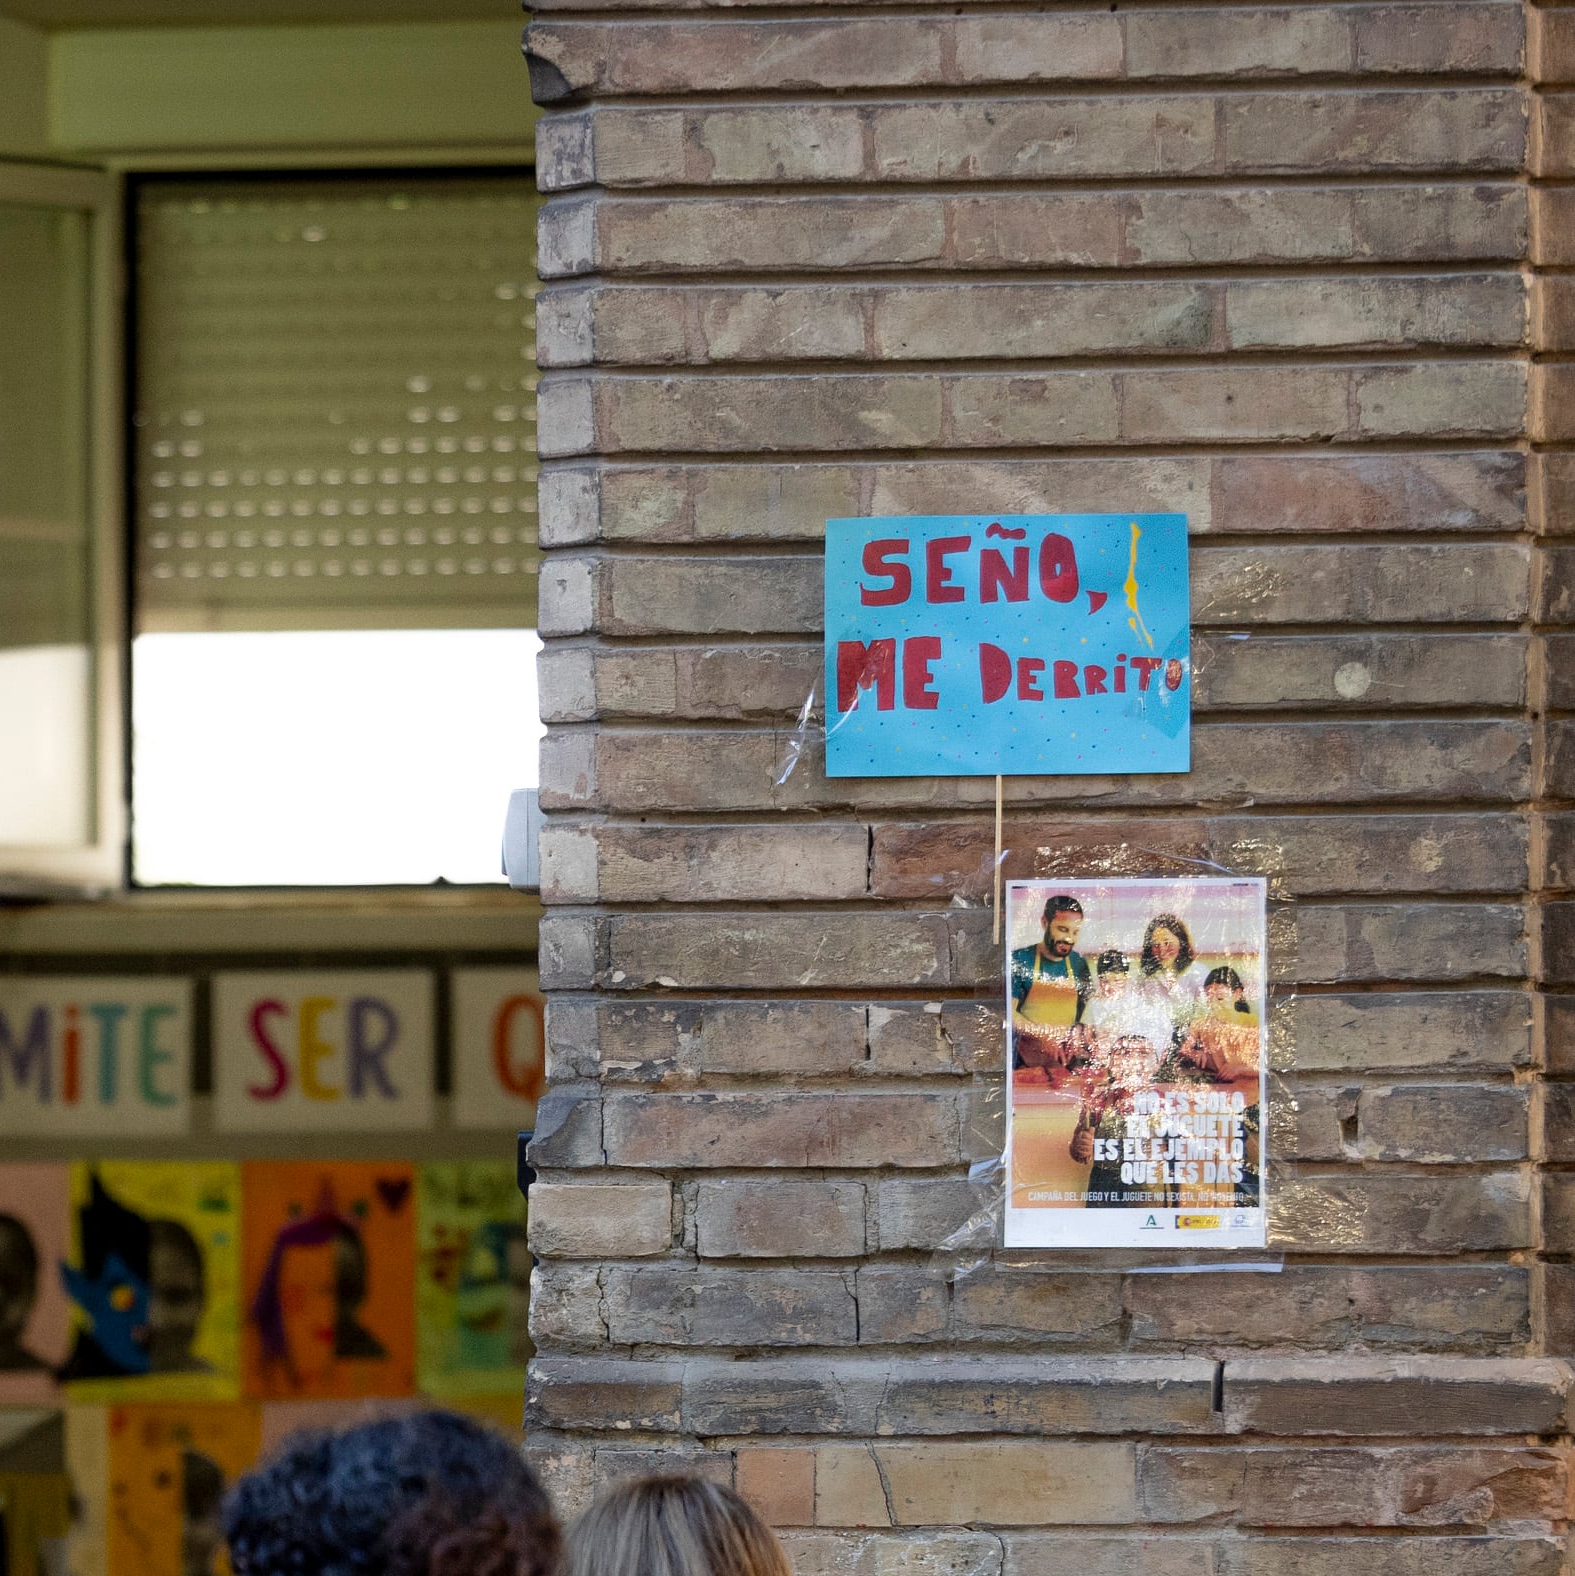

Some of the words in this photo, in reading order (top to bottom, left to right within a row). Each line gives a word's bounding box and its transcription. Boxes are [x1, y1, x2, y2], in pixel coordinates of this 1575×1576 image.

[859, 521, 1109, 616] SEÑO,
[836, 635, 943, 714] ME
[246, 995, 400, 1104] SER
[1134, 1091, 1161, 1114] NO
[1164, 1091, 1189, 1114] ES
[1195, 1091, 1245, 1114] SOLO
[1126, 1115, 1150, 1138] EL
[1154, 1115, 1244, 1138] JUGUETE
[1093, 1138, 1119, 1161] ES
[1123, 1138, 1147, 1161] EL
[1151, 1138, 1245, 1161] EJEMPLO
[1120, 1161, 1158, 1185] QUE
[1163, 1161, 1199, 1184] LES
[1204, 1161, 1244, 1184] DAS
[1028, 1189, 1062, 1202] CAMPAÑA
[1064, 1191, 1079, 1202] DEL
[1080, 1191, 1103, 1202] JUEGO
[1104, 1191, 1110, 1202] Y
[1110, 1191, 1120, 1202] EL
[1121, 1191, 1152, 1202] JUGUETE
[1153, 1191, 1165, 1202] NO
